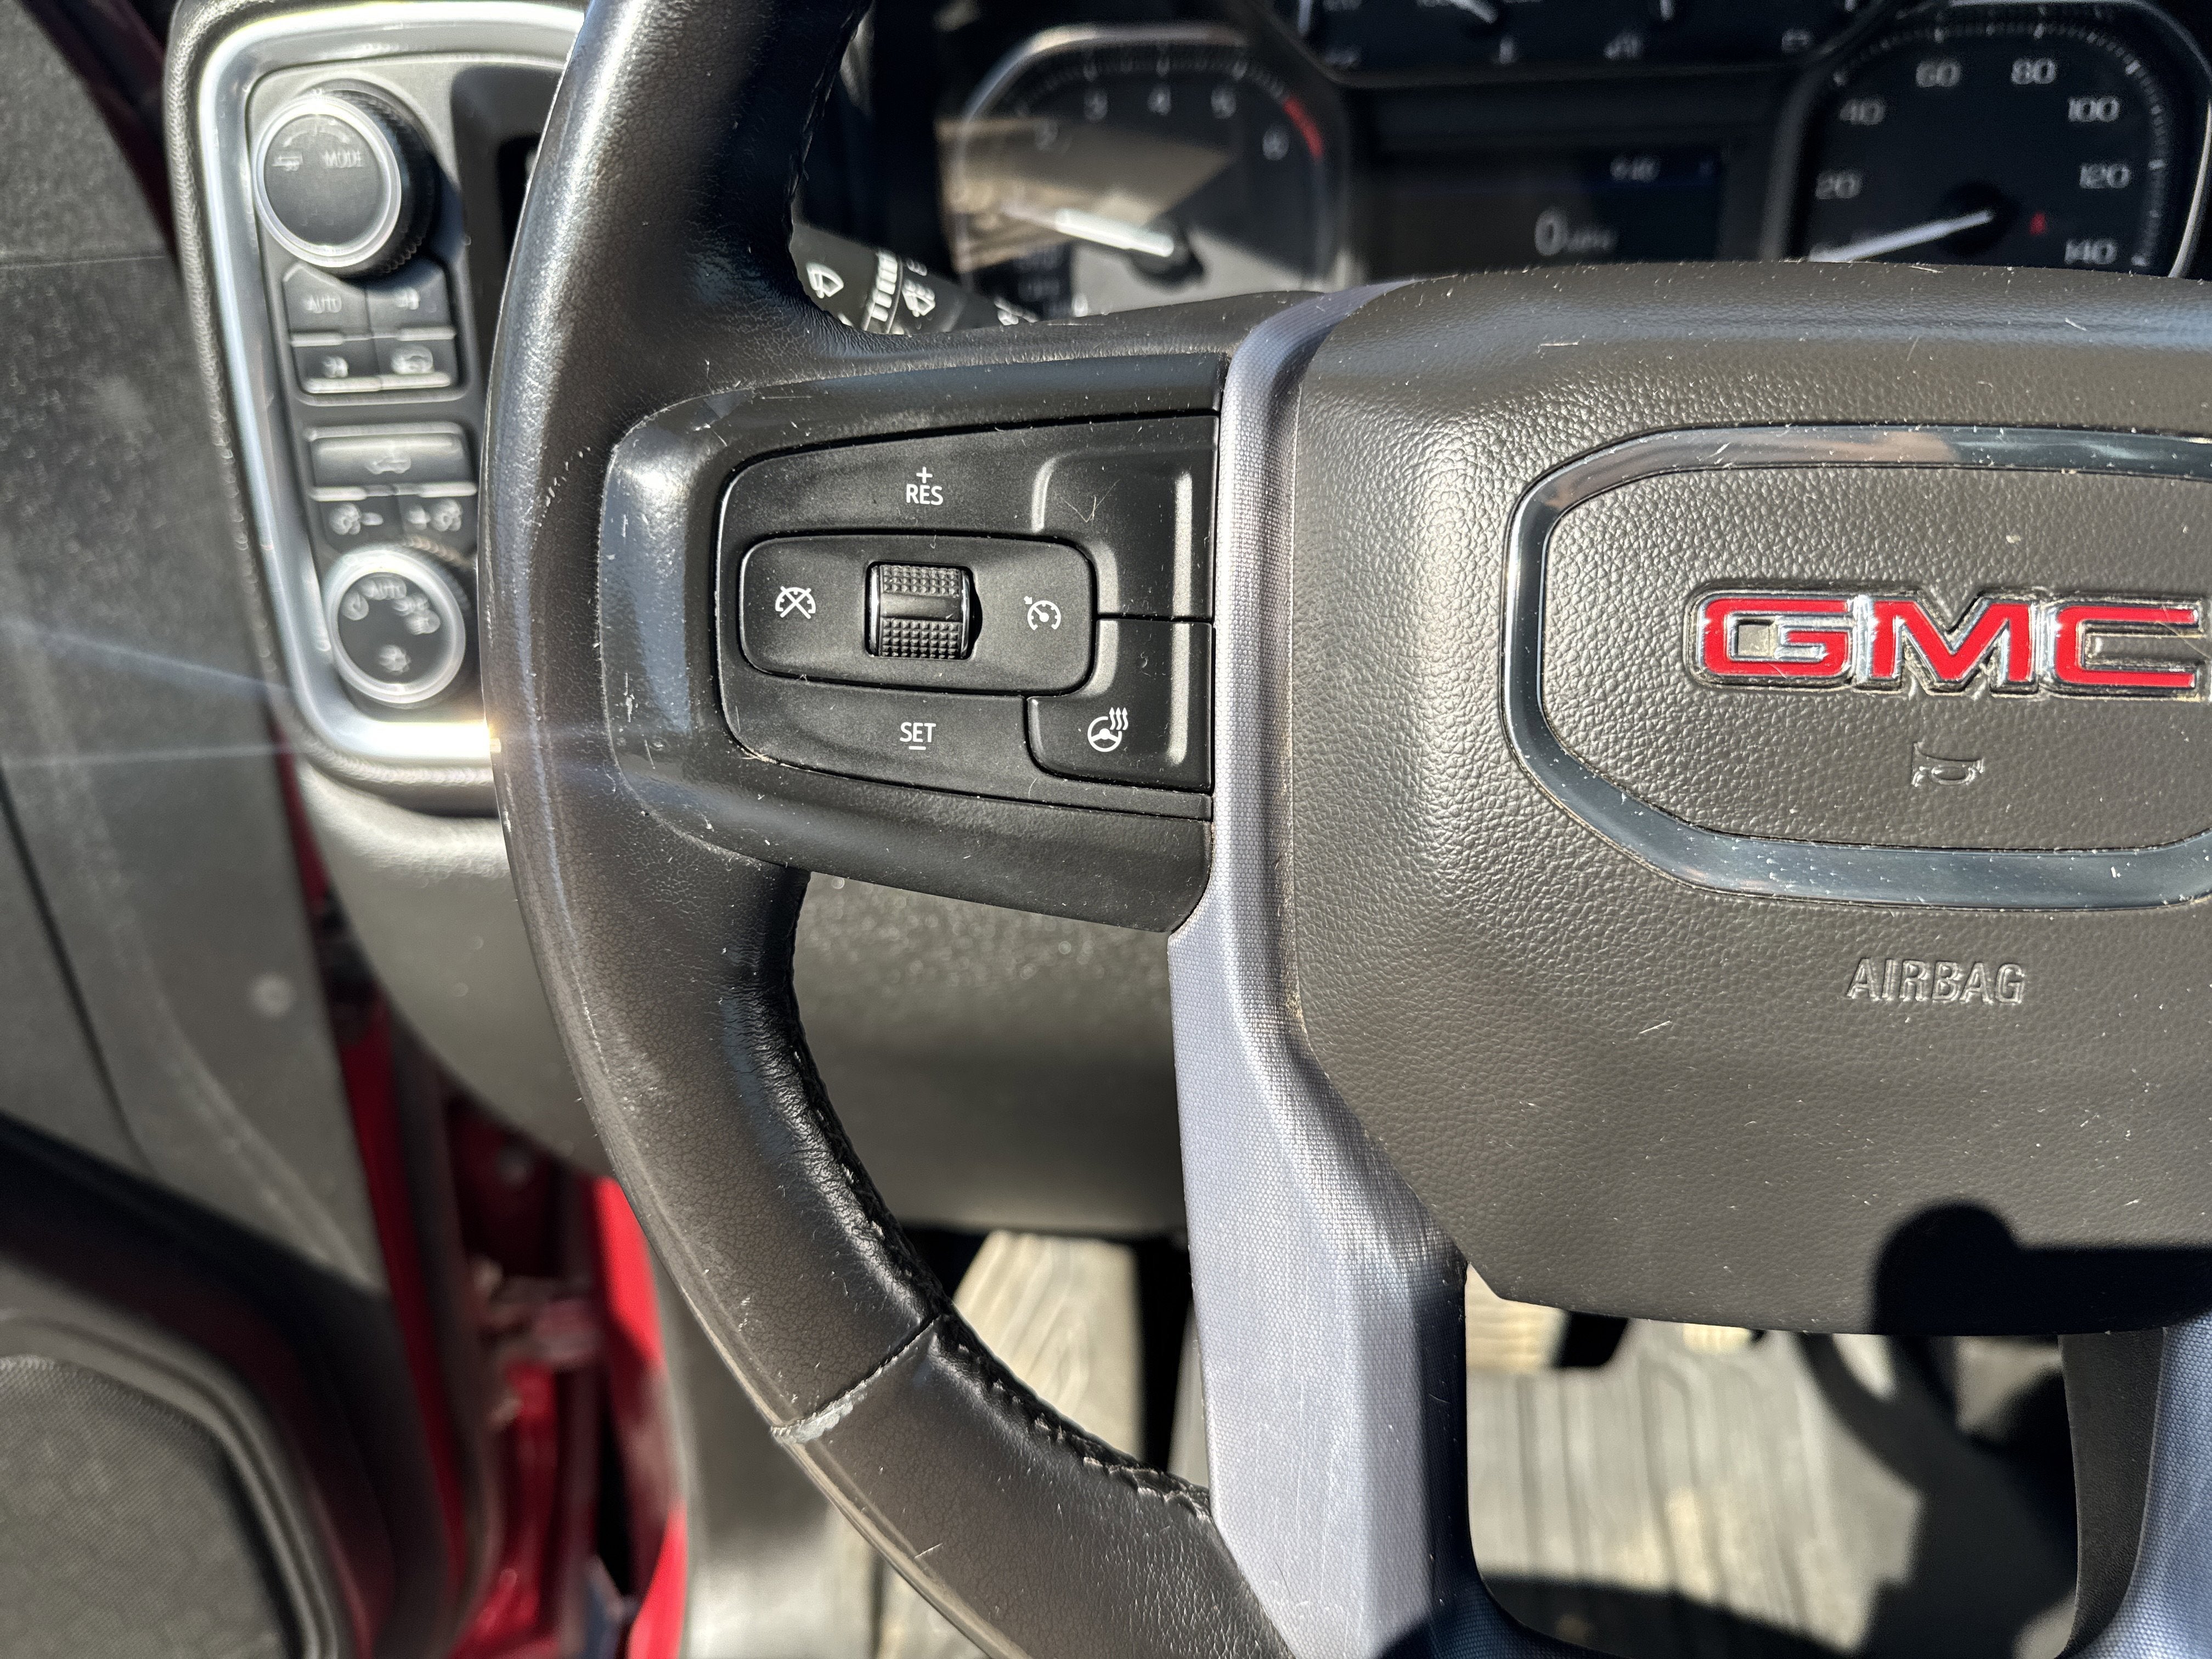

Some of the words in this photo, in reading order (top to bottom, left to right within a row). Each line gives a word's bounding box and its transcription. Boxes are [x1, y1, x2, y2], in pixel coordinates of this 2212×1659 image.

[1916, 59, 1962, 88] 60
[2011, 58, 2057, 84] 80
[1839, 98, 1886, 125] 40
[2068, 95, 2121, 122] 100
[1815, 170, 1863, 200] 20
[2079, 163, 2132, 189] 120
[1534, 208, 1568, 256] 0
[2064, 238, 2118, 264] 140
[906, 483, 944, 505] RES
[1695, 591, 2202, 698] GMC
[899, 721, 936, 743] SET
[1846, 957, 2027, 1004] AIRBAG
